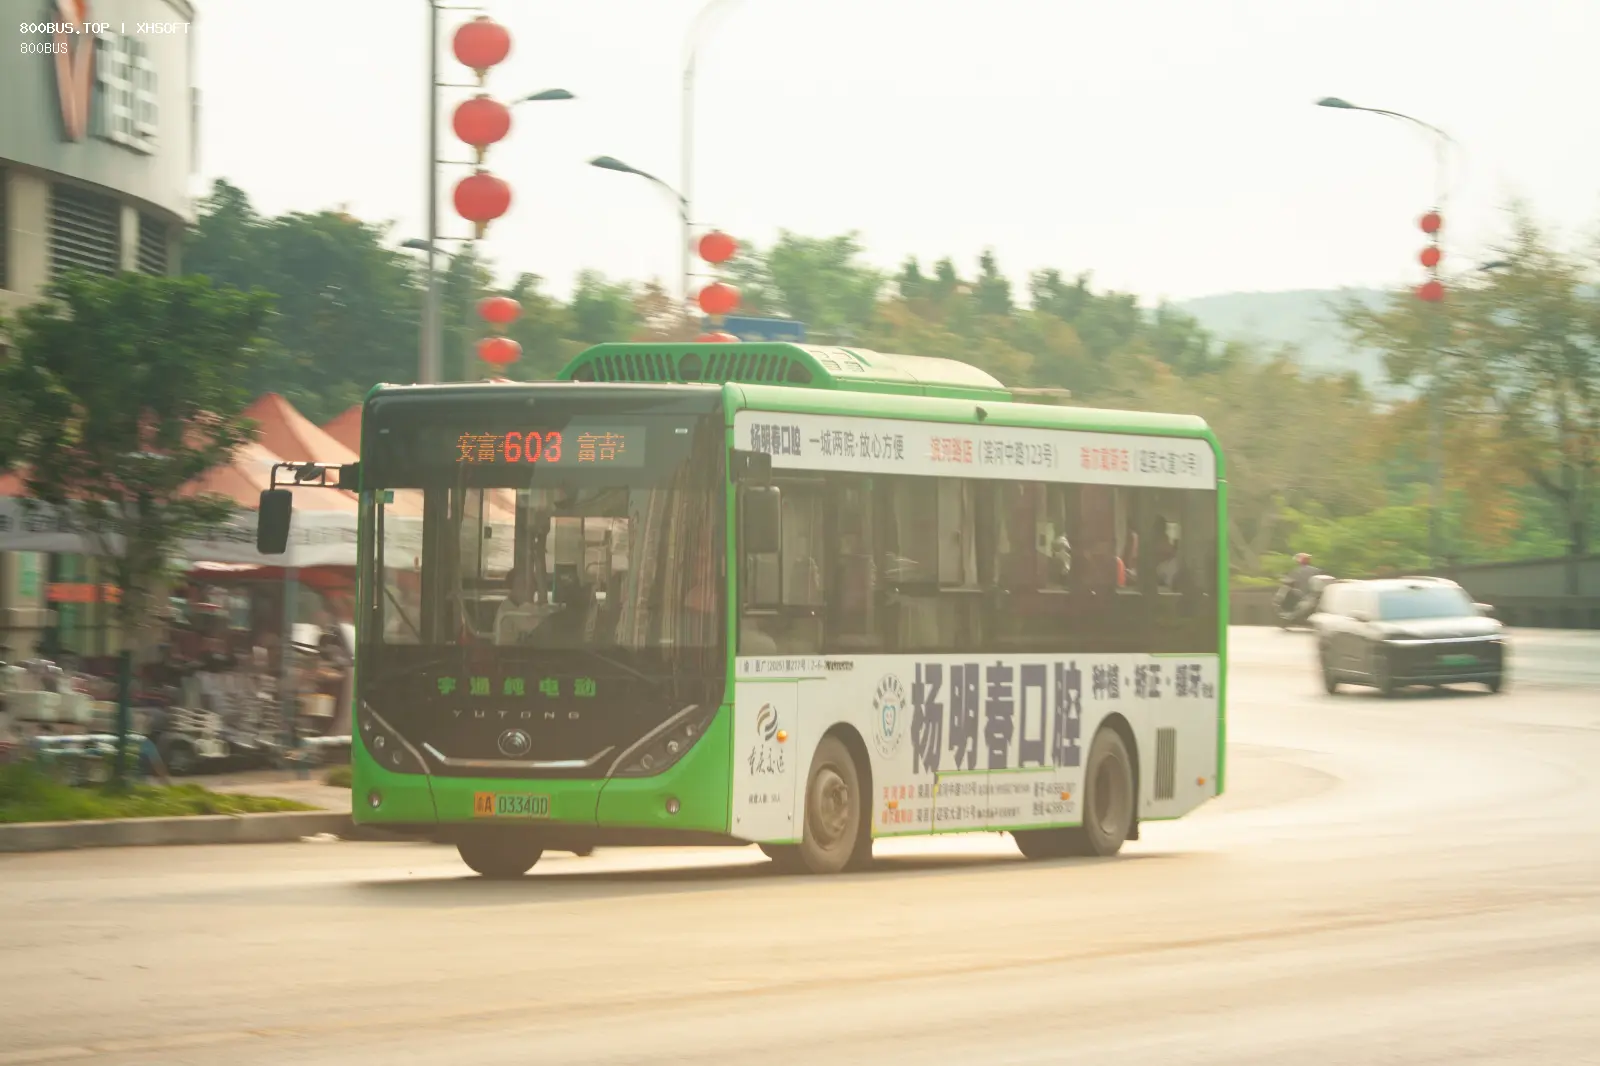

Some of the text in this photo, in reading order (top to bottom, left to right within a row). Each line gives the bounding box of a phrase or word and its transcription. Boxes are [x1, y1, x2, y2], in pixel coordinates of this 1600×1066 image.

[503, 431, 563, 463] 603
[750, 423, 802, 456] 杨明春口腔
[453, 710, 580, 719] YUTONG
[910, 660, 1082, 774] 杨明春口腔
